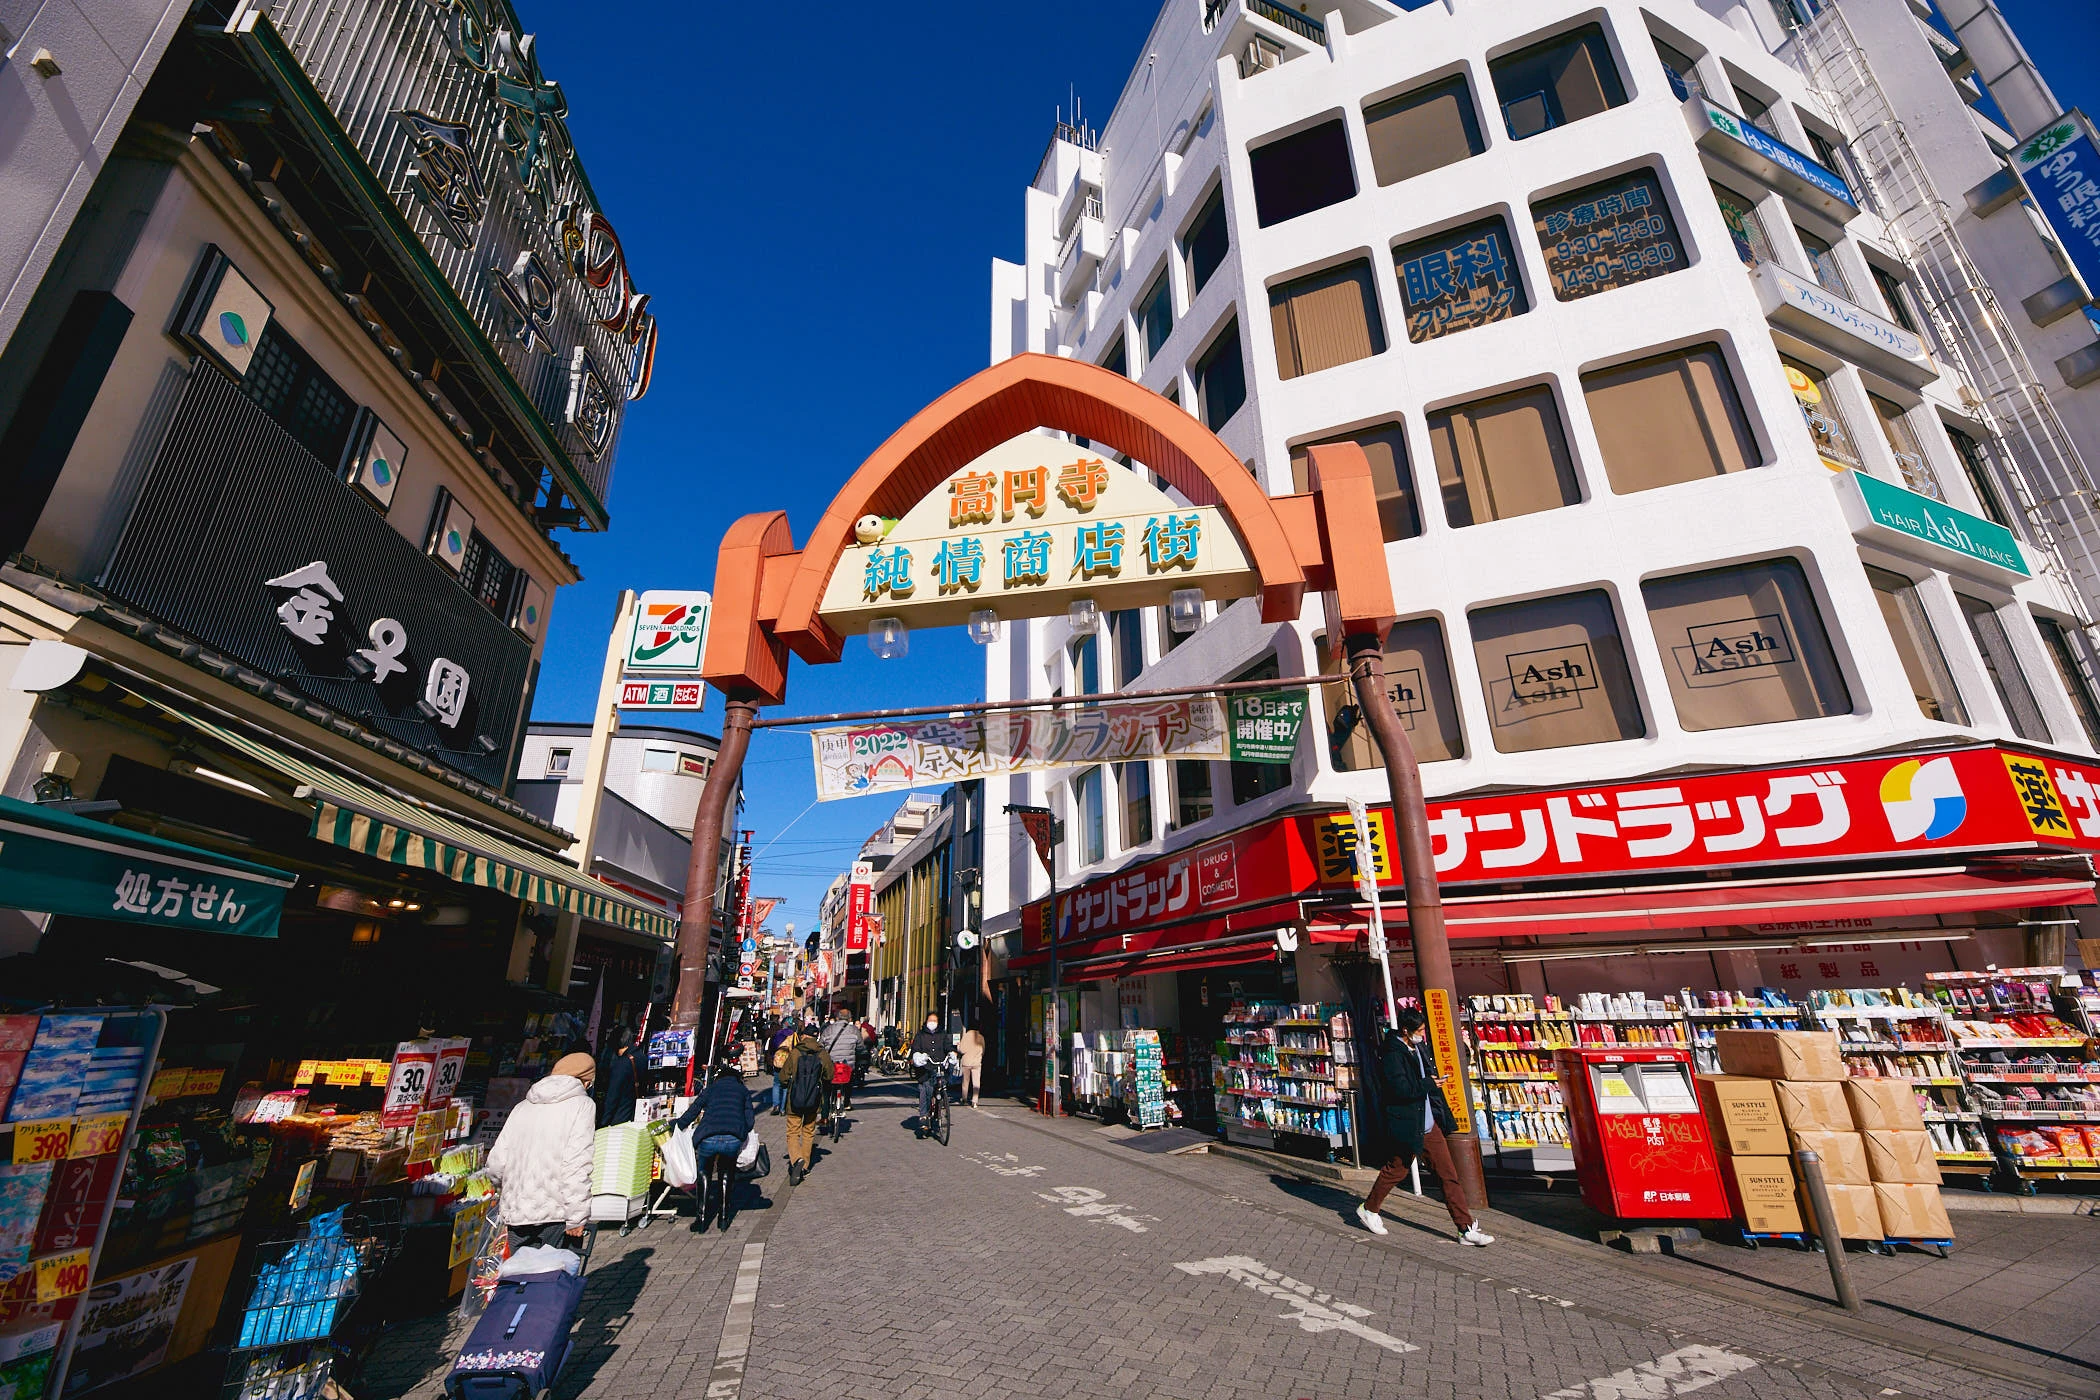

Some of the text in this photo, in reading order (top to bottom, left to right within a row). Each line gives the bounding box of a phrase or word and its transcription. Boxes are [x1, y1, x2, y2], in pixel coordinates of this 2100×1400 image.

[1743, 130, 1849, 201] ゆう眼科クリニック
[1544, 186, 1652, 236] 診療時間
[1403, 234, 1508, 305] 眼科
[1415, 287, 1515, 330] クリニック
[950, 459, 1108, 524] 高円寺
[1879, 507, 2018, 568] HAIR Ash MAKE
[863, 514, 1201, 594] 純情商店街
[667, 624, 700, 632] HOLDINGS
[1706, 631, 1780, 657] Ash
[1521, 659, 1585, 685] Ash
[623, 687, 699, 702] ATM 酒 たばこ
[1387, 683, 1416, 702] sh
[1233, 697, 1302, 717] 18日まで
[854, 732, 909, 756] 2022
[914, 702, 1188, 777] 歳末スクラッチ
[2009, 763, 2100, 838] 薬 サ
[1427, 769, 1851, 873] サンドラッグ
[1203, 851, 1228, 867] DRUG
[1320, 821, 1384, 878] 薬
[1202, 878, 1235, 896] COSMETIC
[1214, 869, 1220, 879] &
[113, 868, 246, 924] 処方せん
[1075, 857, 1191, 933] サンドラッグ
[1781, 961, 1880, 980] 紙製品
[400, 1068, 426, 1093] 30%
[1643, 1117, 1661, 1129] 郵便
[31, 1131, 68, 1161] 398
[1646, 1136, 1665, 1146] POST
[1660, 1192, 1691, 1202] 日本郵便
[55, 1263, 88, 1295] 490
